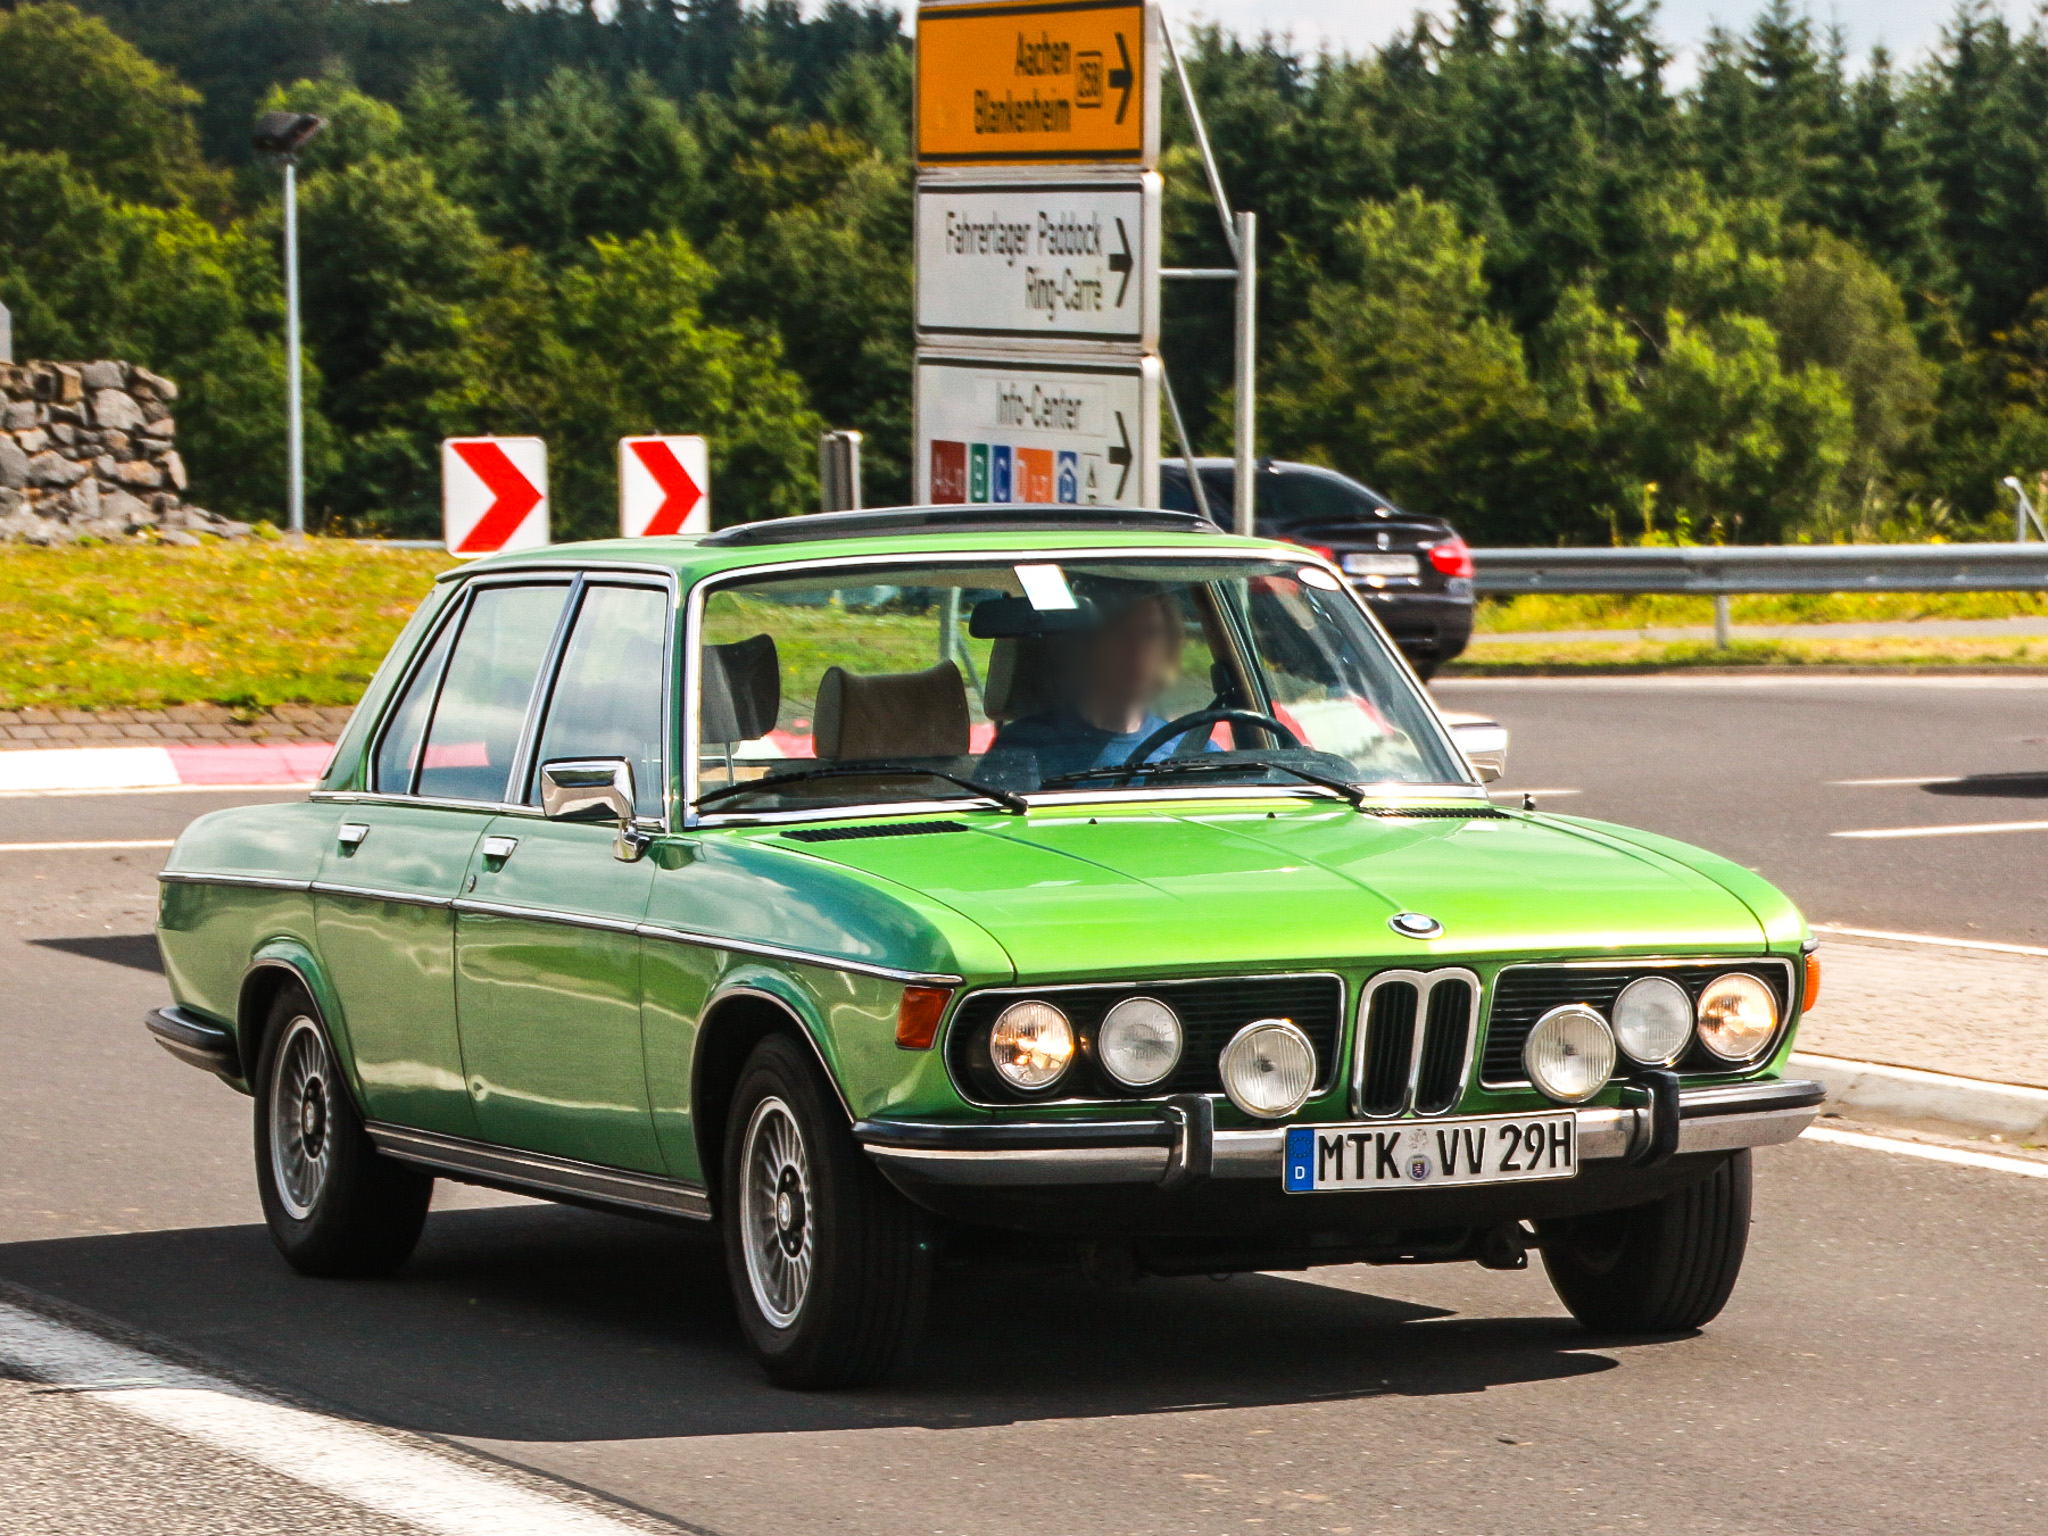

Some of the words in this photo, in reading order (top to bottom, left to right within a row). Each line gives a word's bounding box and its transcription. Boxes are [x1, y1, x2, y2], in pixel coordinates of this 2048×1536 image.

[1014, 31, 1072, 77] Aachen
[974, 88, 1072, 135] Blankenheim
[945, 210, 1031, 267] Fahrerlager
[1036, 211, 1102, 257] Paddock
[995, 381, 1083, 431] Info-Center
[1294, 1166, 1306, 1180] D
[1317, 1130, 1401, 1181] MTK
[1436, 1127, 1487, 1176] VV
[1499, 1120, 1572, 1172] 29H
